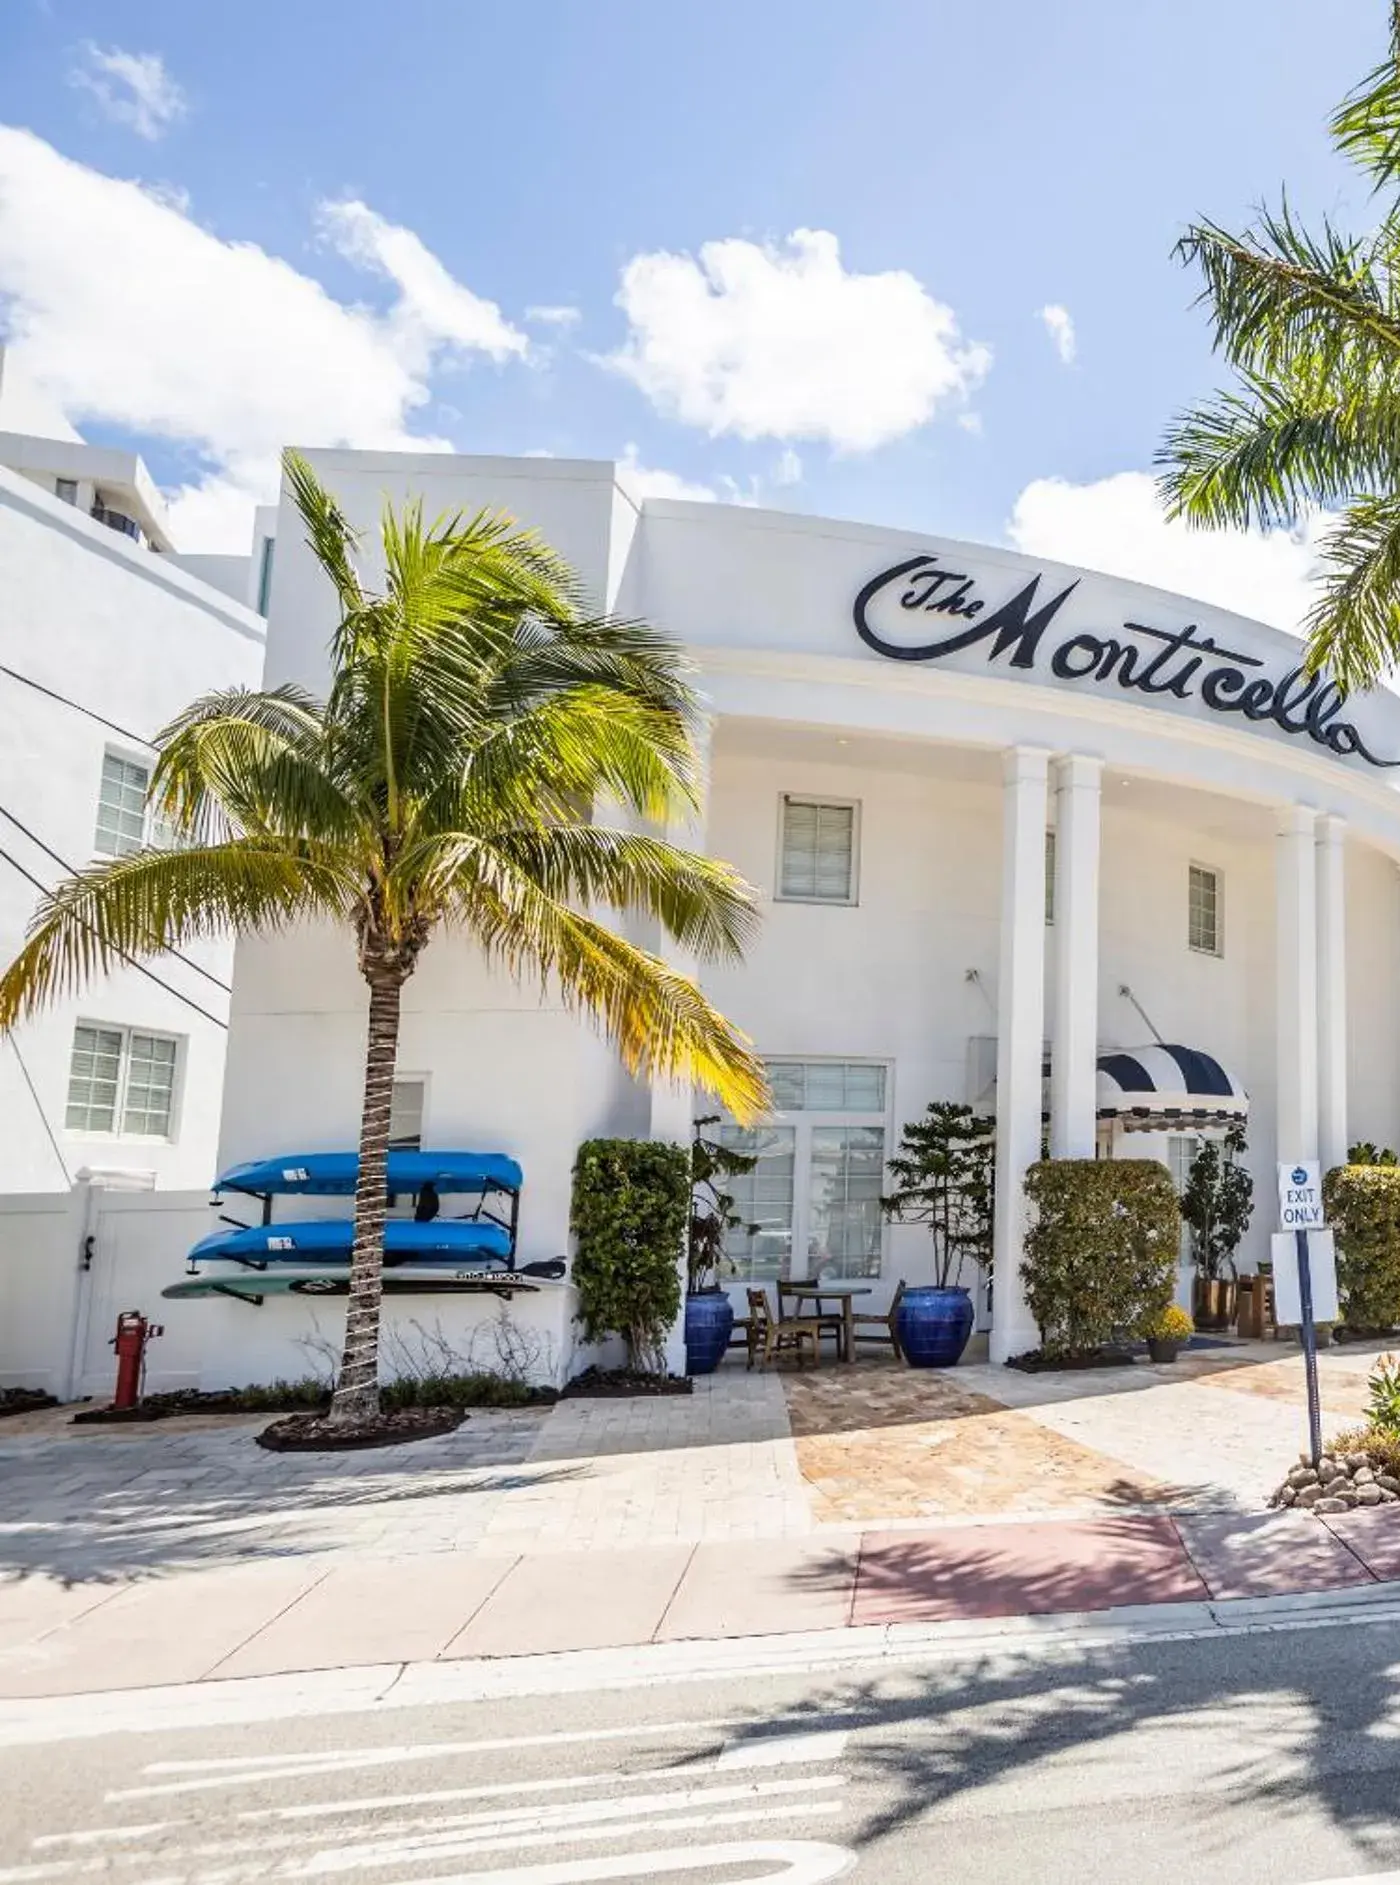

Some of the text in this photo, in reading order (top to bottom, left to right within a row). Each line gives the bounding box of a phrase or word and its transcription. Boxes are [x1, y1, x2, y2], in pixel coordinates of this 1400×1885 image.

[900, 570, 985, 619] The
[1287, 1189, 1315, 1203] EXIT
[1284, 1208, 1319, 1224] ONLY
